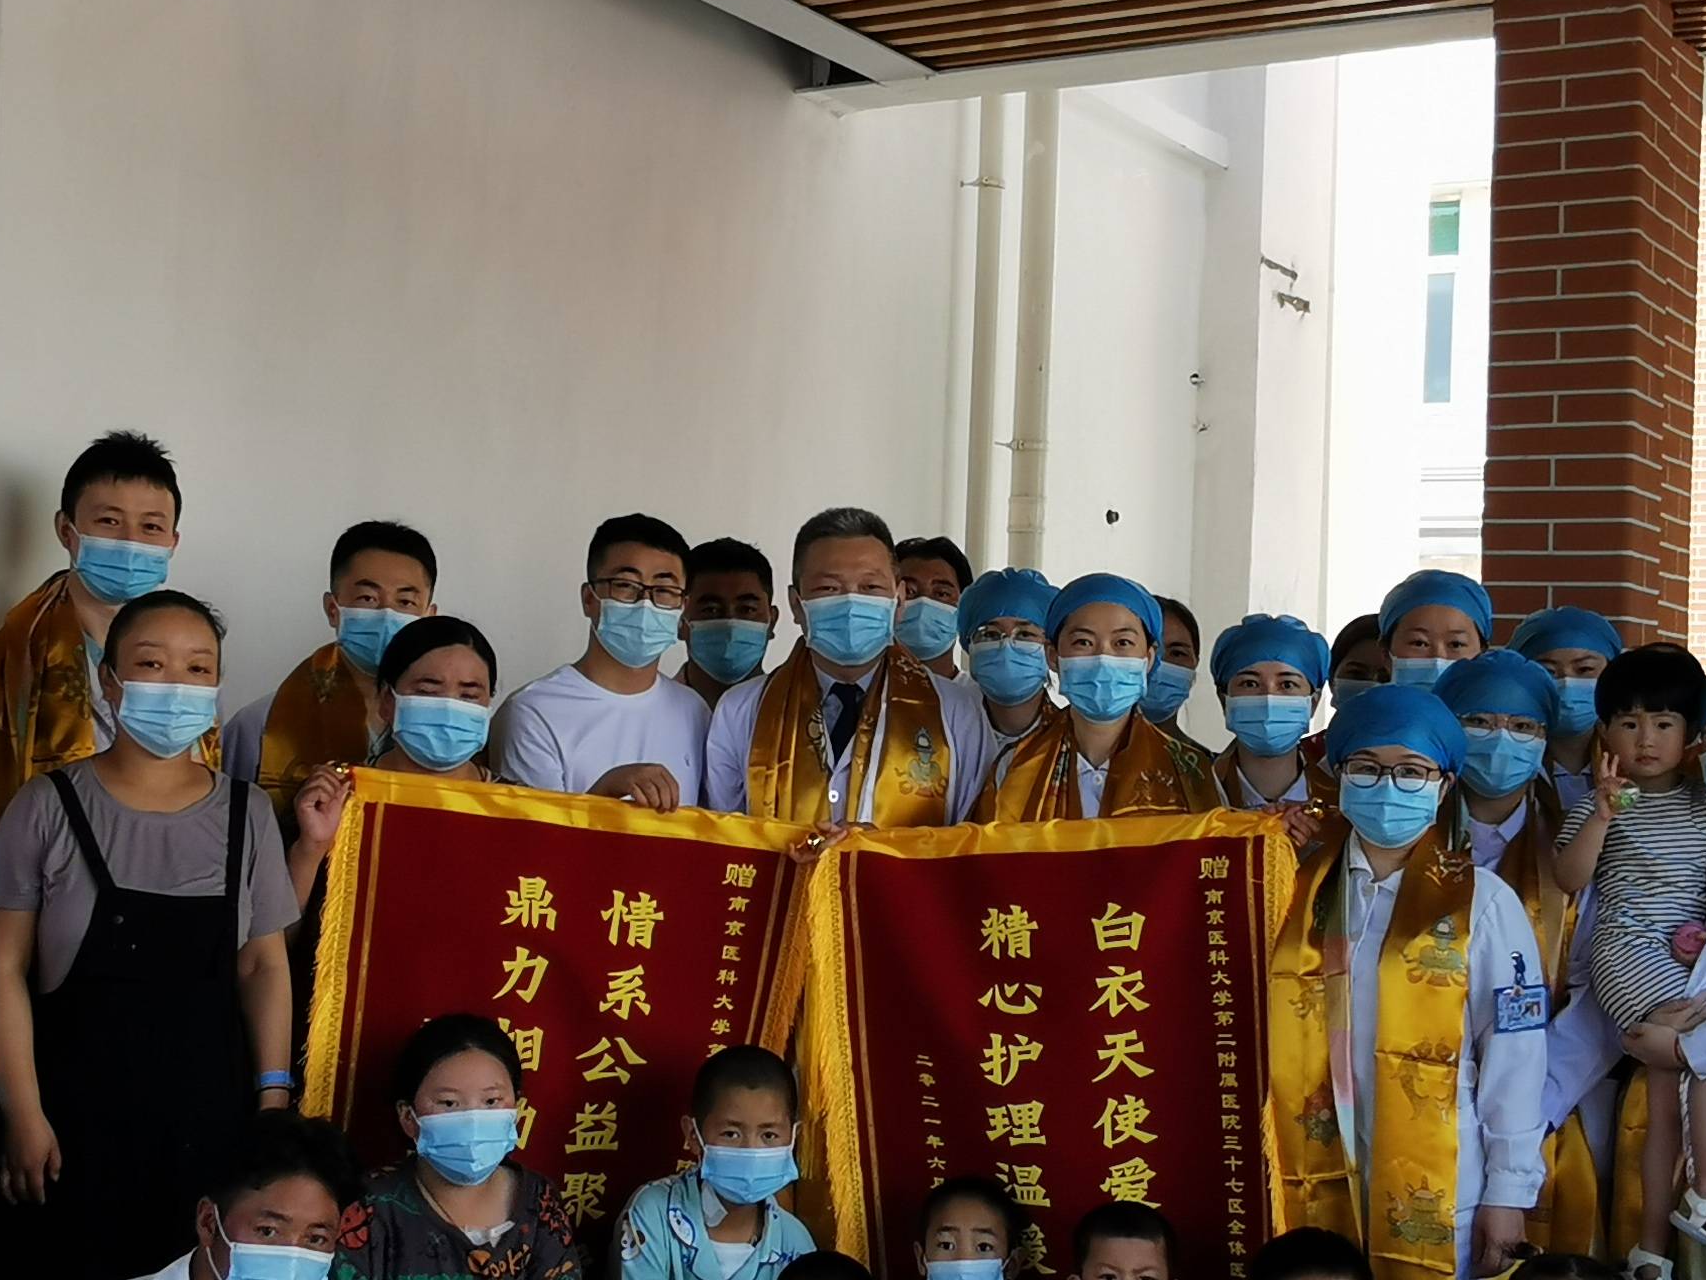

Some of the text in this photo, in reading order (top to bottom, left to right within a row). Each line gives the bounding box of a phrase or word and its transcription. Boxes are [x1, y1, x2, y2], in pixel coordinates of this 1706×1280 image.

[560, 889, 664, 1227] 情系公益聚
[1088, 901, 1162, 1210] 白衣天使爱
